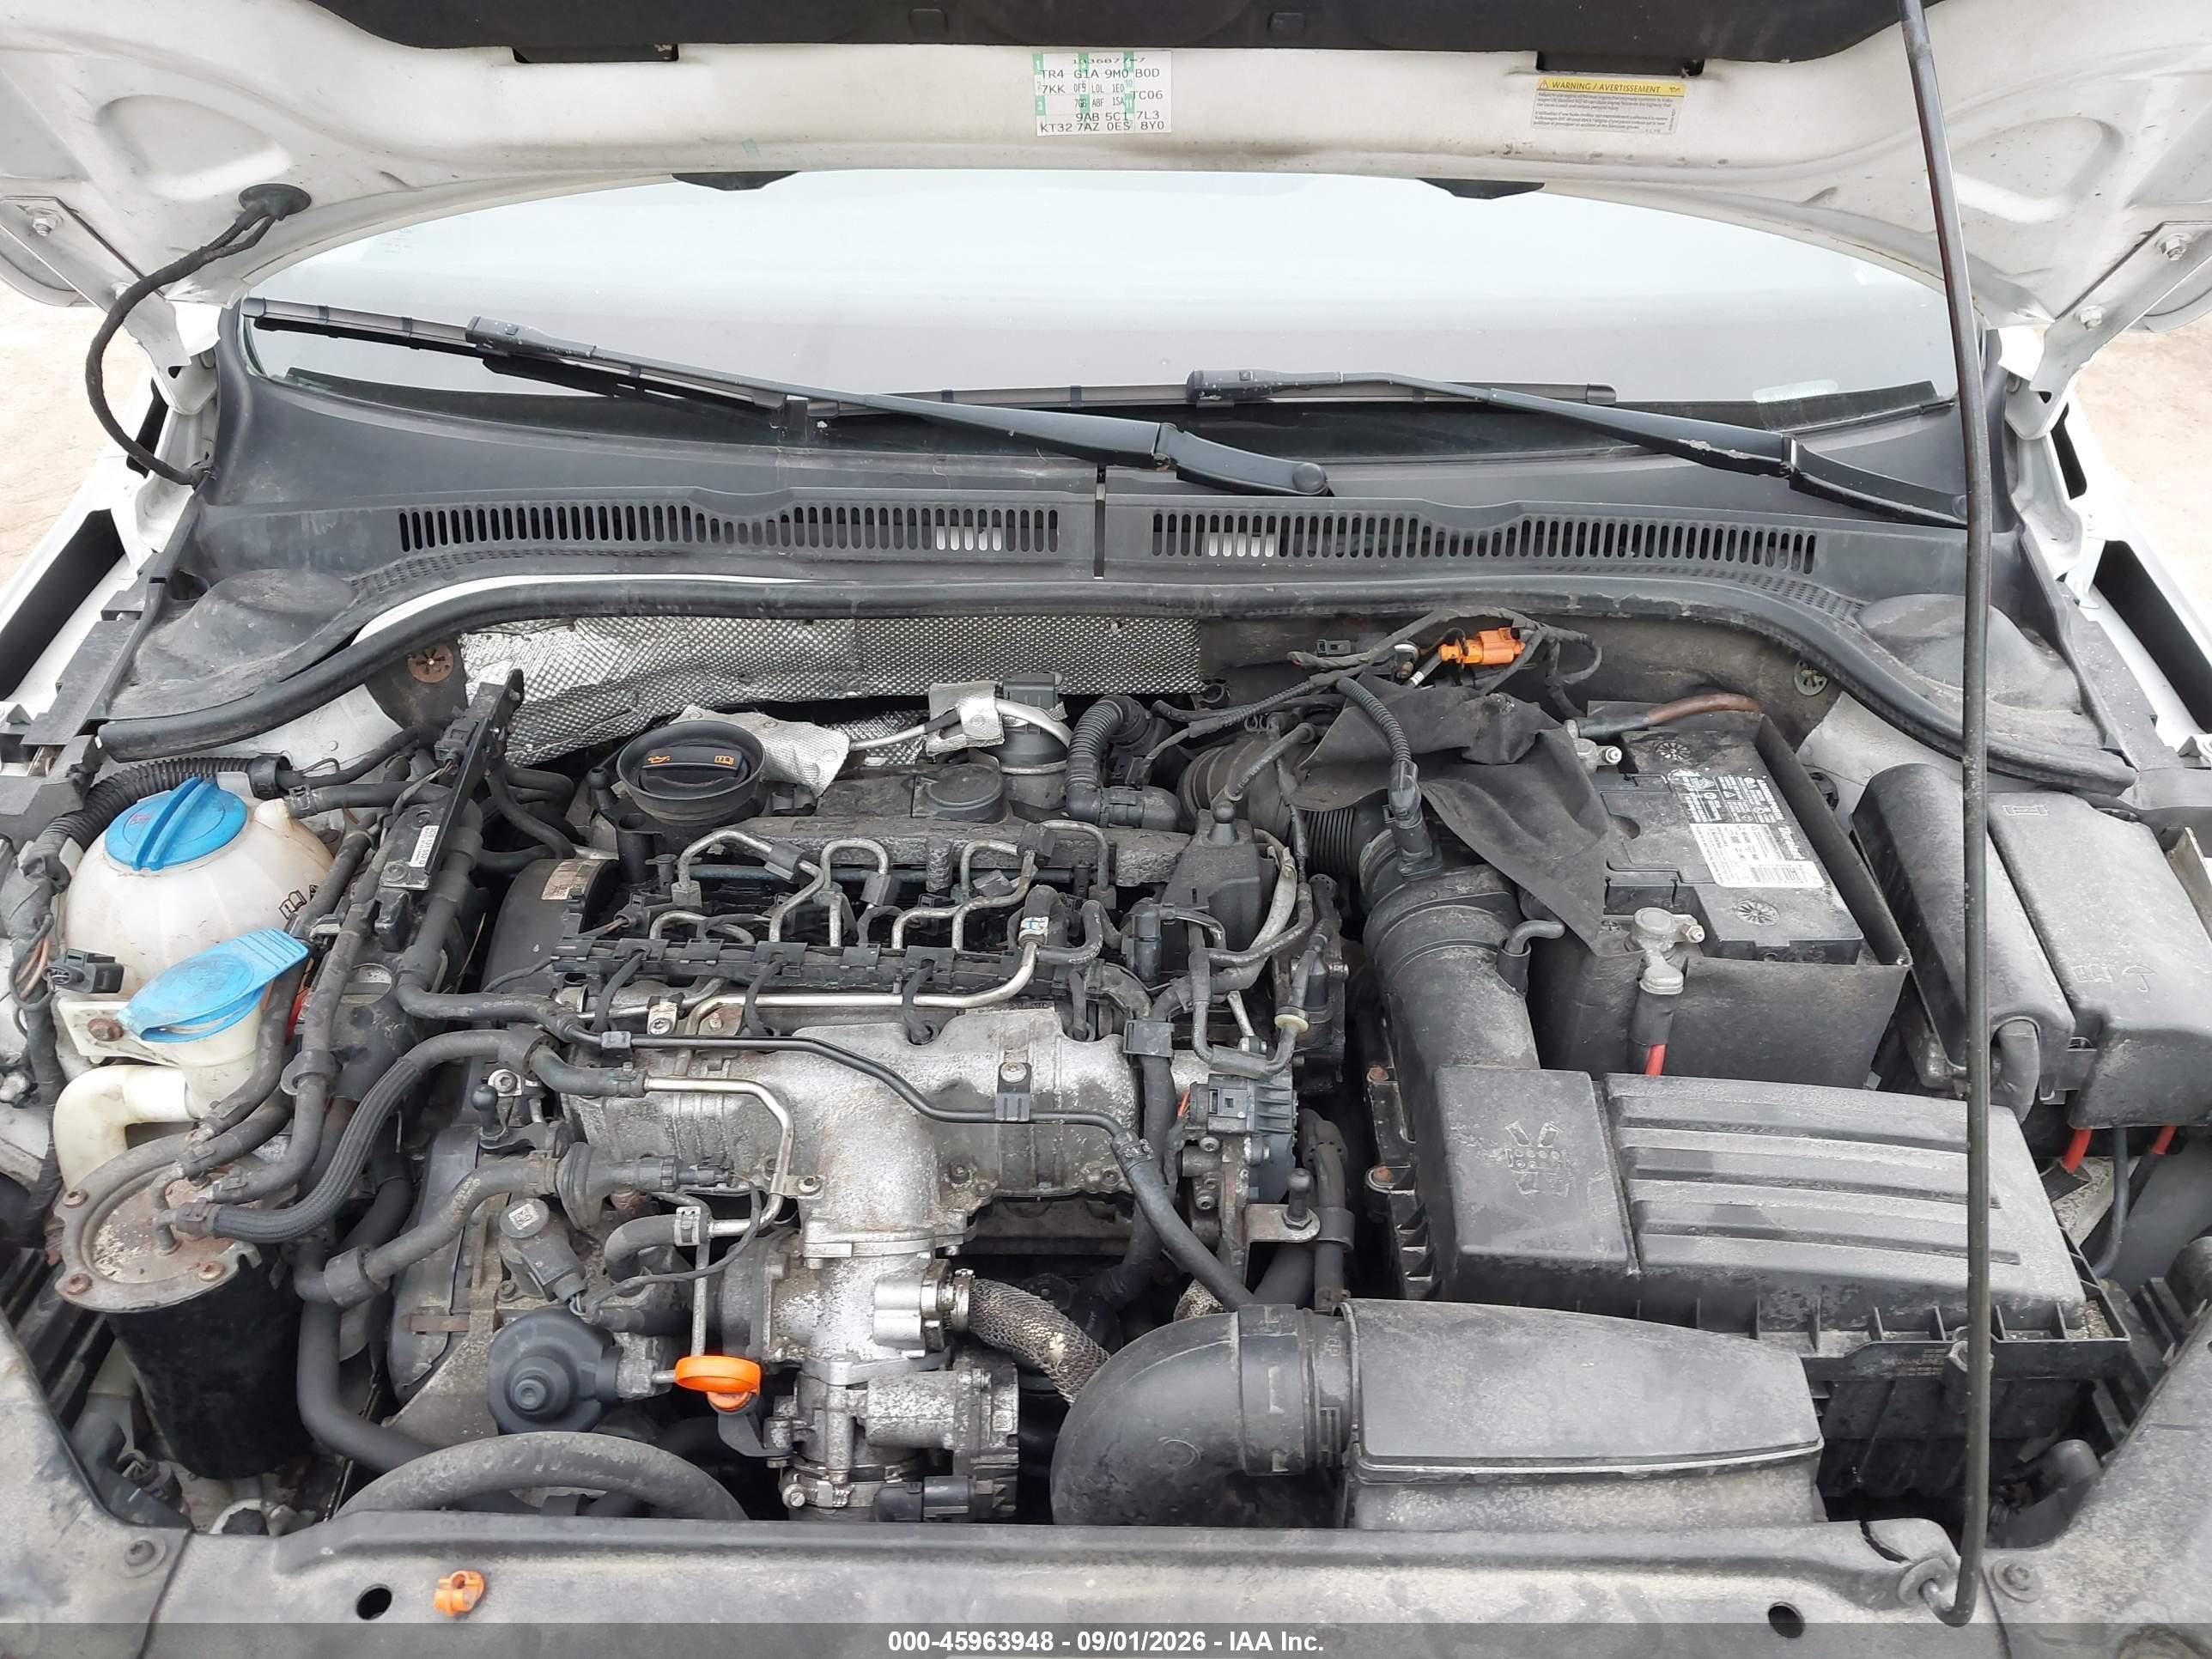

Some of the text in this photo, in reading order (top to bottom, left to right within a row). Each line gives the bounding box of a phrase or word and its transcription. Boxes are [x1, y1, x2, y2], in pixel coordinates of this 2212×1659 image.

[1040, 70, 1064, 80] TR4
[1073, 69, 1100, 79] G1A
[1042, 84, 1066, 94] 7KK
[1552, 81, 1591, 90] WARNING
[1599, 82, 1662, 94] AVERTISSEMENT
[1075, 110, 1160, 122] 9AB 5C1 7L3
[1040, 121, 1073, 133] KT32
[1077, 122, 1100, 131] 7AZ
